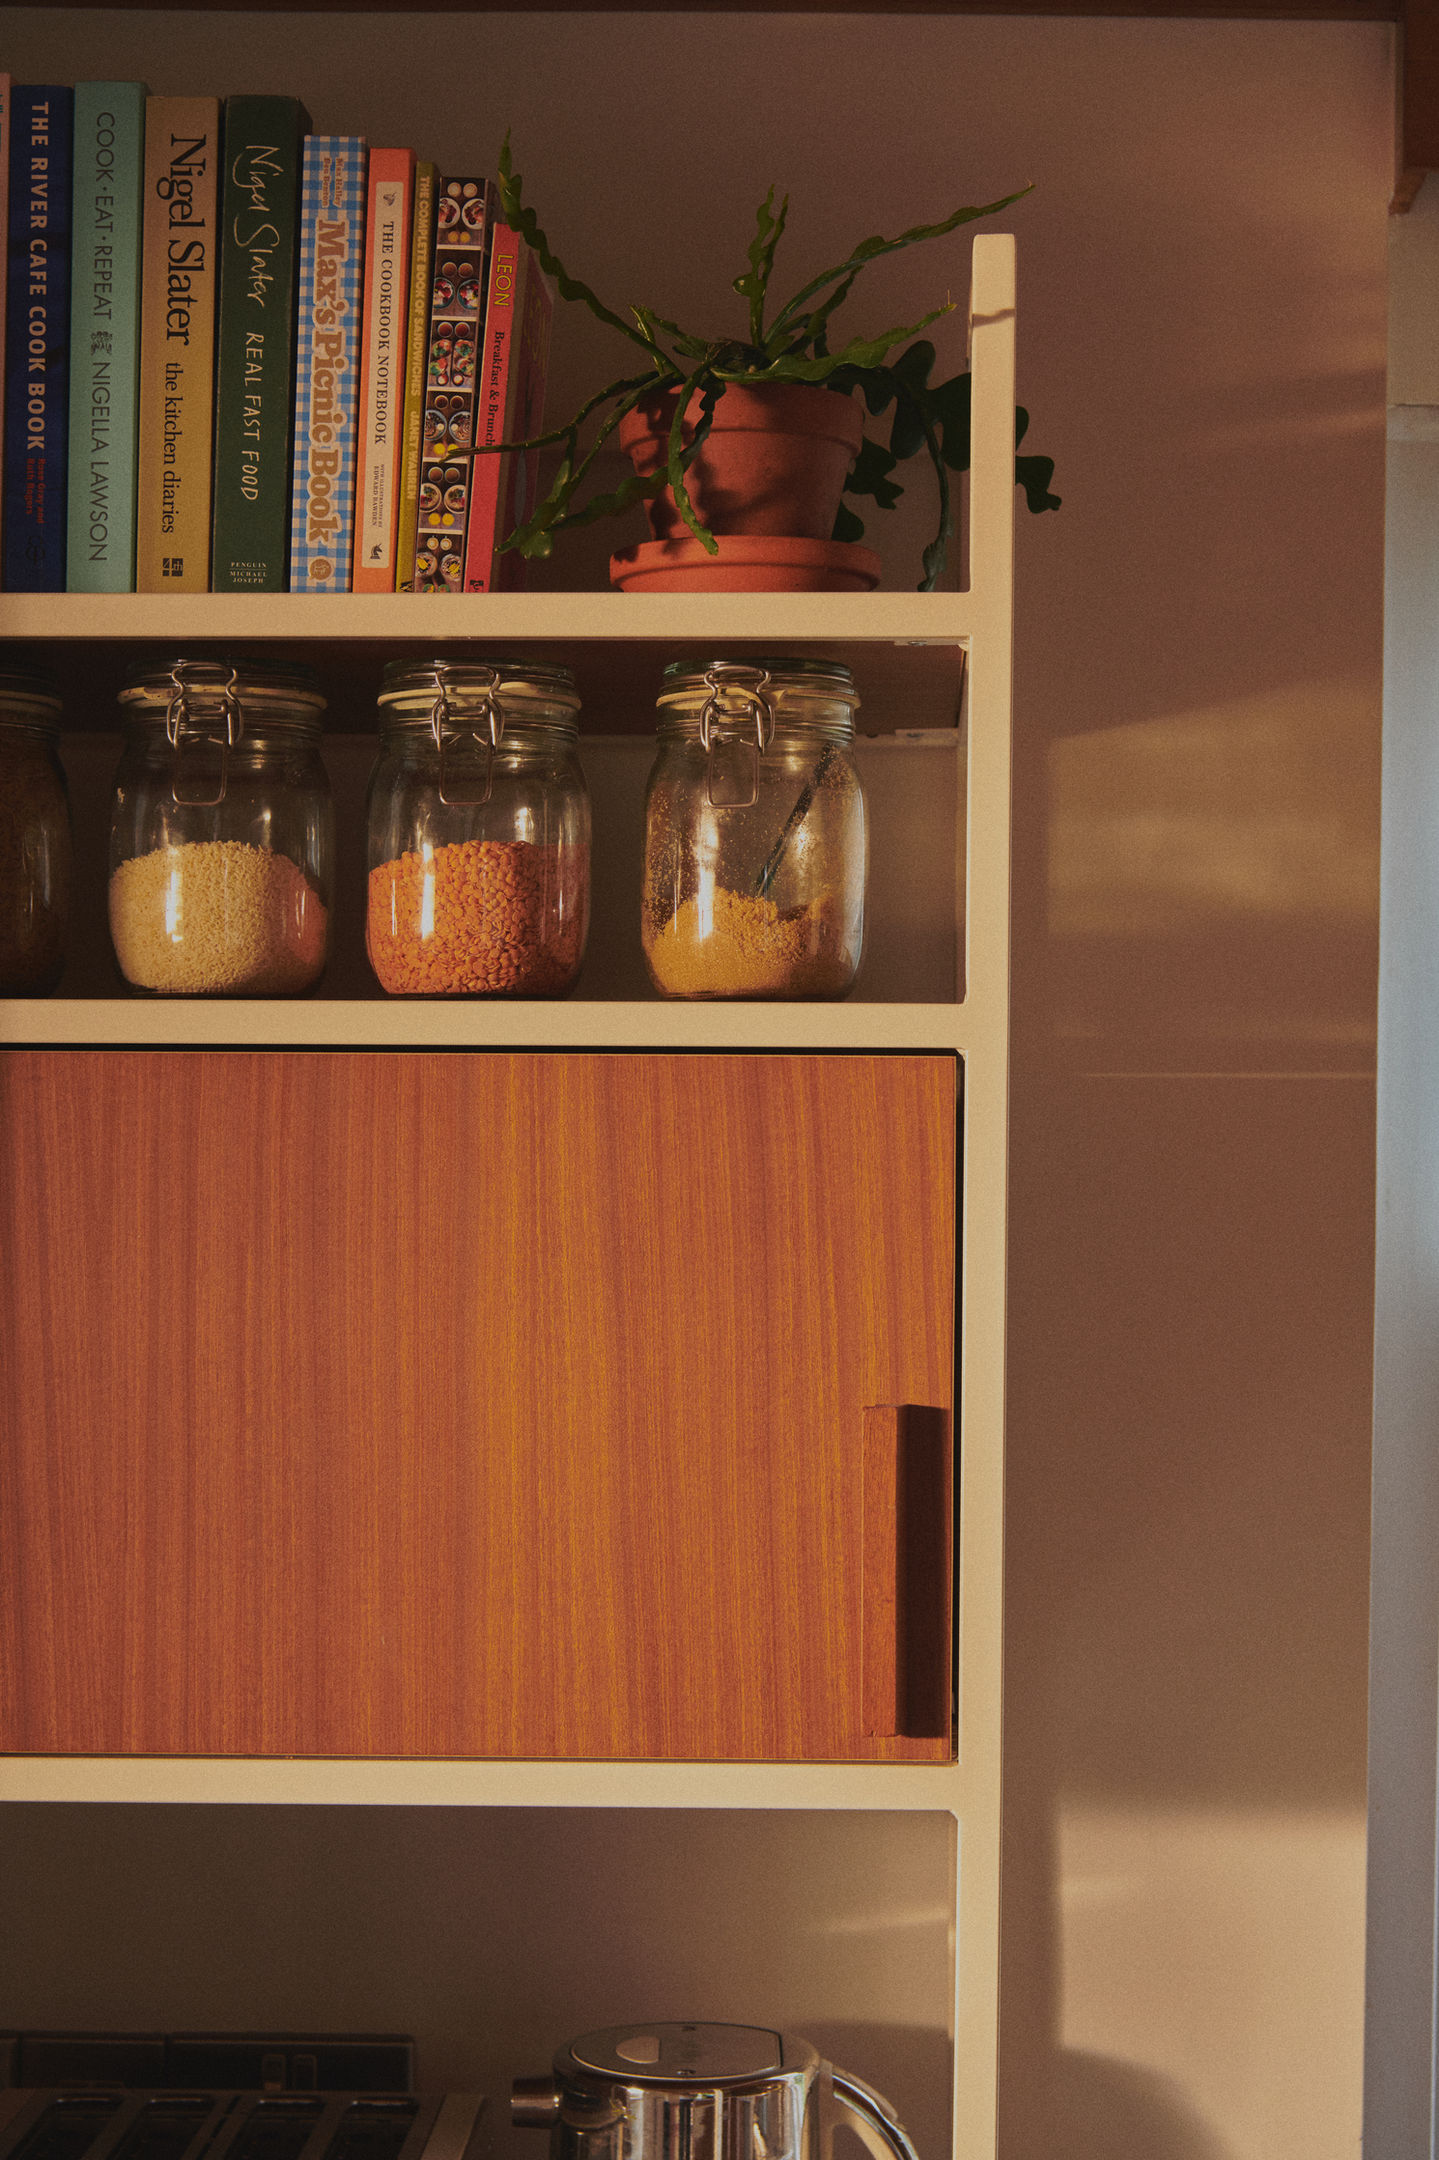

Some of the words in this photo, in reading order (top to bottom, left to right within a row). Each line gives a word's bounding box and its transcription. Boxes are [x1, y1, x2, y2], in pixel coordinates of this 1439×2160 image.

[31, 101, 48, 146] THE
[95, 112, 115, 182] COOK
[30, 157, 48, 229] RIVER
[157, 133, 207, 230] Nigel
[232, 145, 284, 212] Nigel
[419, 175, 430, 197] THE
[95, 195, 114, 233] EAT
[382, 221, 394, 254] THE
[416, 199, 429, 262] COMPLETE
[29, 239, 47, 295] CAFE
[93, 246, 113, 320] REPEAT
[166, 239, 205, 346] Slater
[414, 264, 426, 298] BOOK
[494, 254, 513, 307] LEON
[377, 260, 393, 350] COOKBOOK
[413, 299, 425, 316] OF
[28, 306, 47, 372] COOK
[244, 332, 264, 387] REAL
[410, 317, 424, 397] SANDWICHES
[490, 331, 505, 386] Breakfast
[90, 362, 111, 453] NIGELLA
[165, 362, 184, 392] the
[311, 330, 348, 446] Picnic
[374, 356, 389, 444] NOTEBOOK
[489, 390, 500, 401] &
[27, 383, 46, 450] BOOK
[163, 396, 184, 465] kitchen
[243, 394, 262, 441] FAST
[408, 411, 420, 449] JANET
[485, 403, 499, 447] Brunch
[161, 470, 182, 534] diaries
[240, 450, 260, 501] FOOD
[309, 449, 340, 542] Book
[406, 450, 419, 499] WARREN
[88, 461, 109, 561] LAWSON
